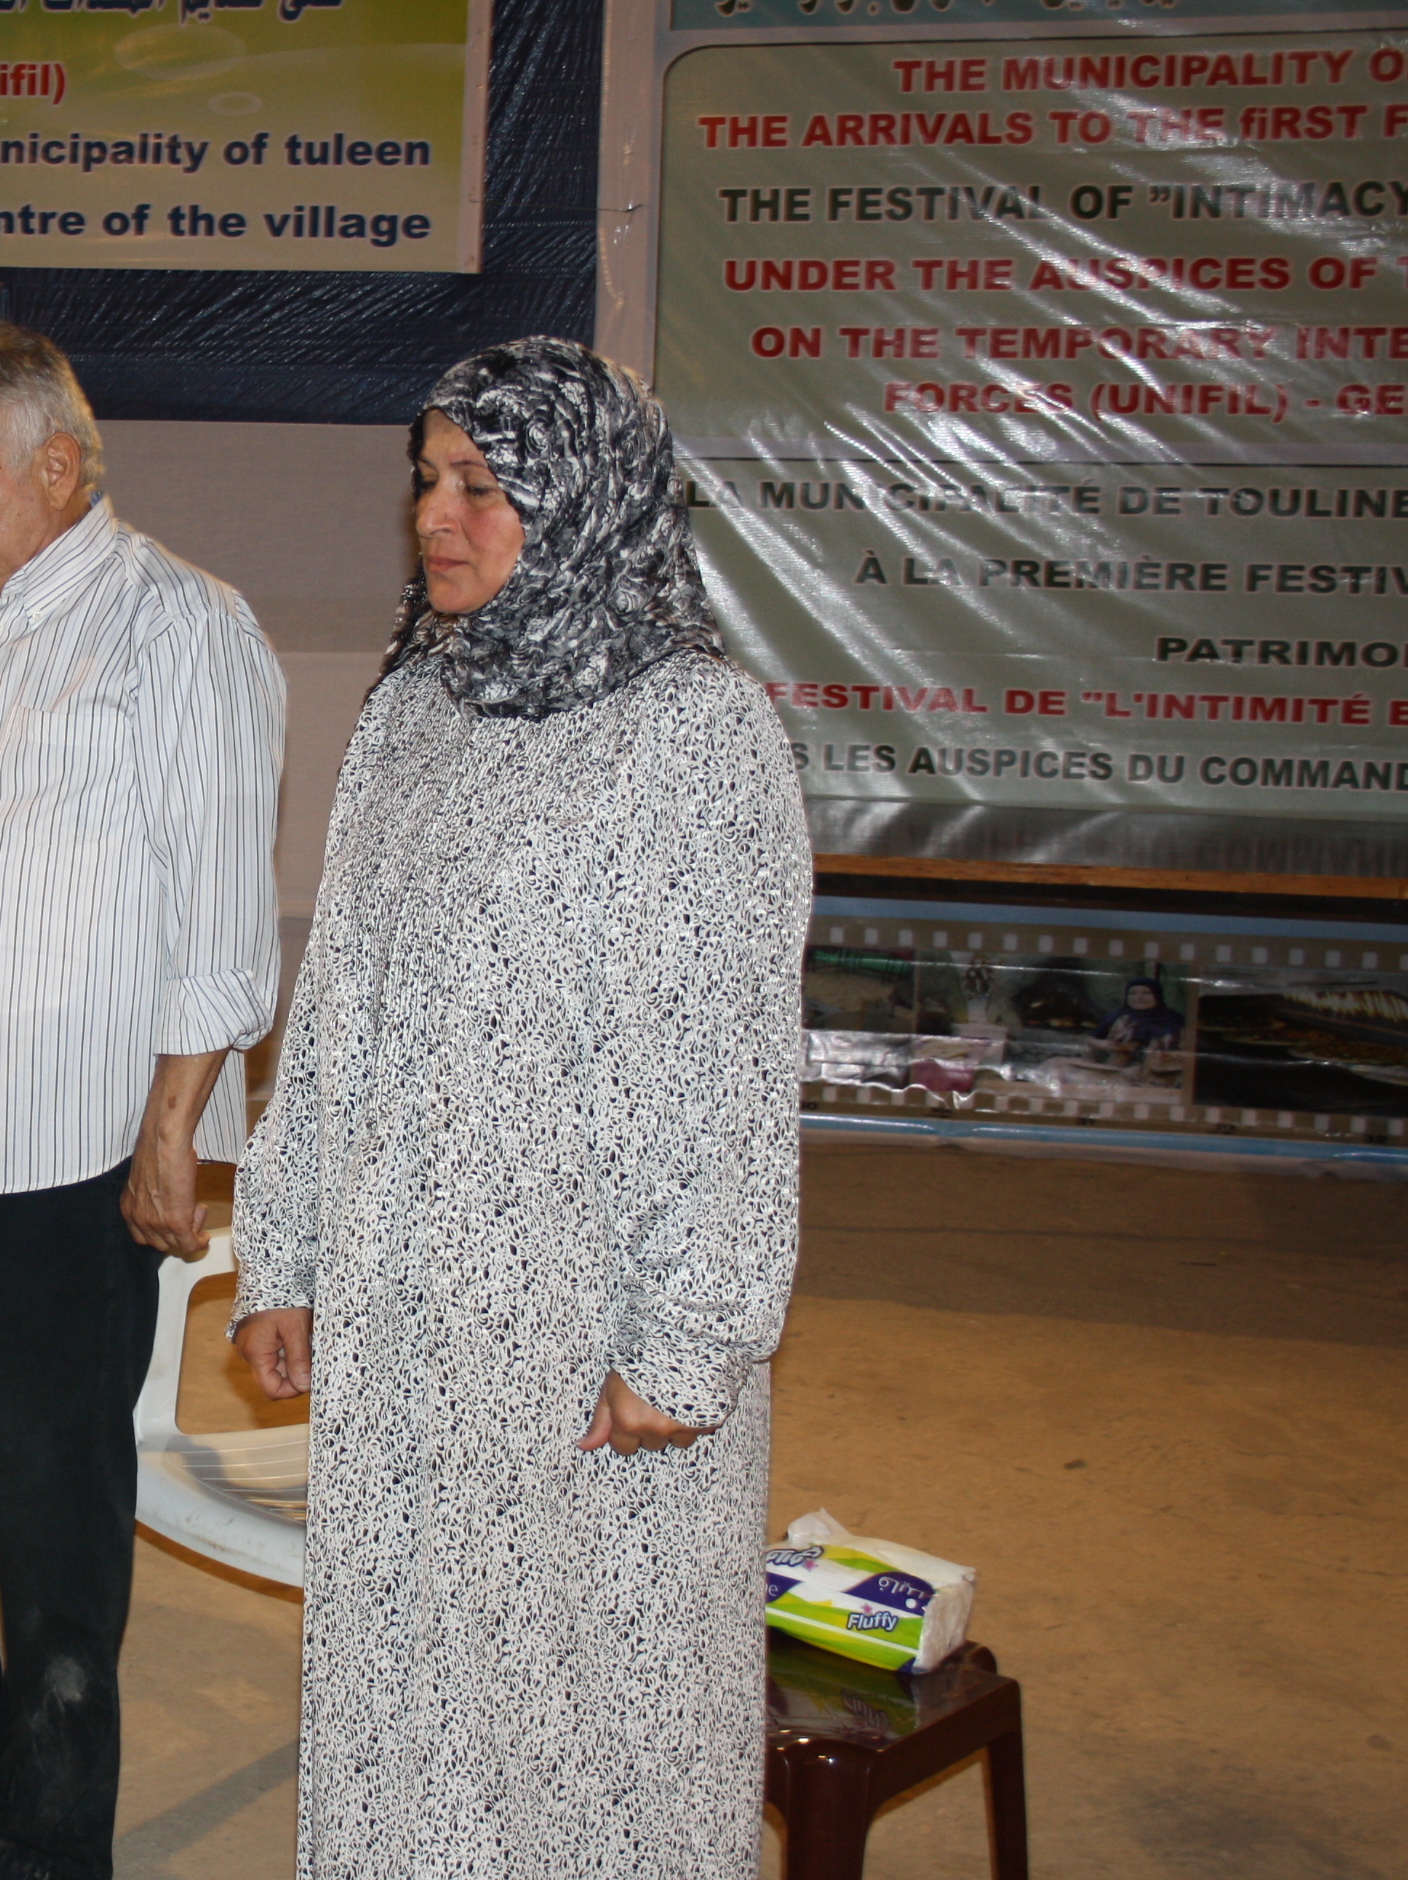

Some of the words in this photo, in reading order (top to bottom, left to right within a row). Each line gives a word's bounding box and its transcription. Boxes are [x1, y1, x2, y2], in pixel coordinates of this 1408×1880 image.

[894, 58, 986, 92] THE
[1003, 50, 1353, 90] MUNICIPALITY
[1369, 47, 1408, 82] O
[698, 115, 788, 148] THE
[802, 111, 1033, 147] ARRIVALS
[1049, 111, 1112, 144] TO
[1127, 107, 1226, 143] THE
[1239, 104, 1366, 140] fiRST
[222, 133, 266, 166] of
[286, 134, 431, 168] tuleen
[720, 188, 811, 222] THE
[827, 184, 1042, 222] FESTIVAL
[1070, 185, 1133, 220] OF
[102, 203, 149, 237] of
[168, 204, 247, 239] the
[263, 206, 431, 248] village
[724, 259, 895, 291] UNDER
[912, 258, 1013, 291] THE
[1029, 256, 1290, 291] AUSPICES
[1308, 256, 1377, 290] OF
[752, 327, 822, 358] ON
[839, 327, 938, 358] THE
[956, 325, 1276, 360] TEMPORARY
[885, 381, 1073, 413] FORCES
[1092, 382, 1288, 423] (UNIFIL)
[759, 478, 1100, 514] MUNCIPALITÉ
[1118, 486, 1181, 515] DE
[854, 550, 886, 584] À
[903, 557, 961, 586] LA
[979, 555, 1227, 591] PREMIÈRE
[1157, 637, 1408, 668] PATRIMO
[764, 683, 988, 713] FESTIVAL
[1004, 690, 1067, 715] DE
[823, 744, 896, 773] LES
[908, 747, 1113, 781] AUSPICES
[1128, 754, 1184, 784] DU
[846, 1611, 899, 1632] Fluffy
